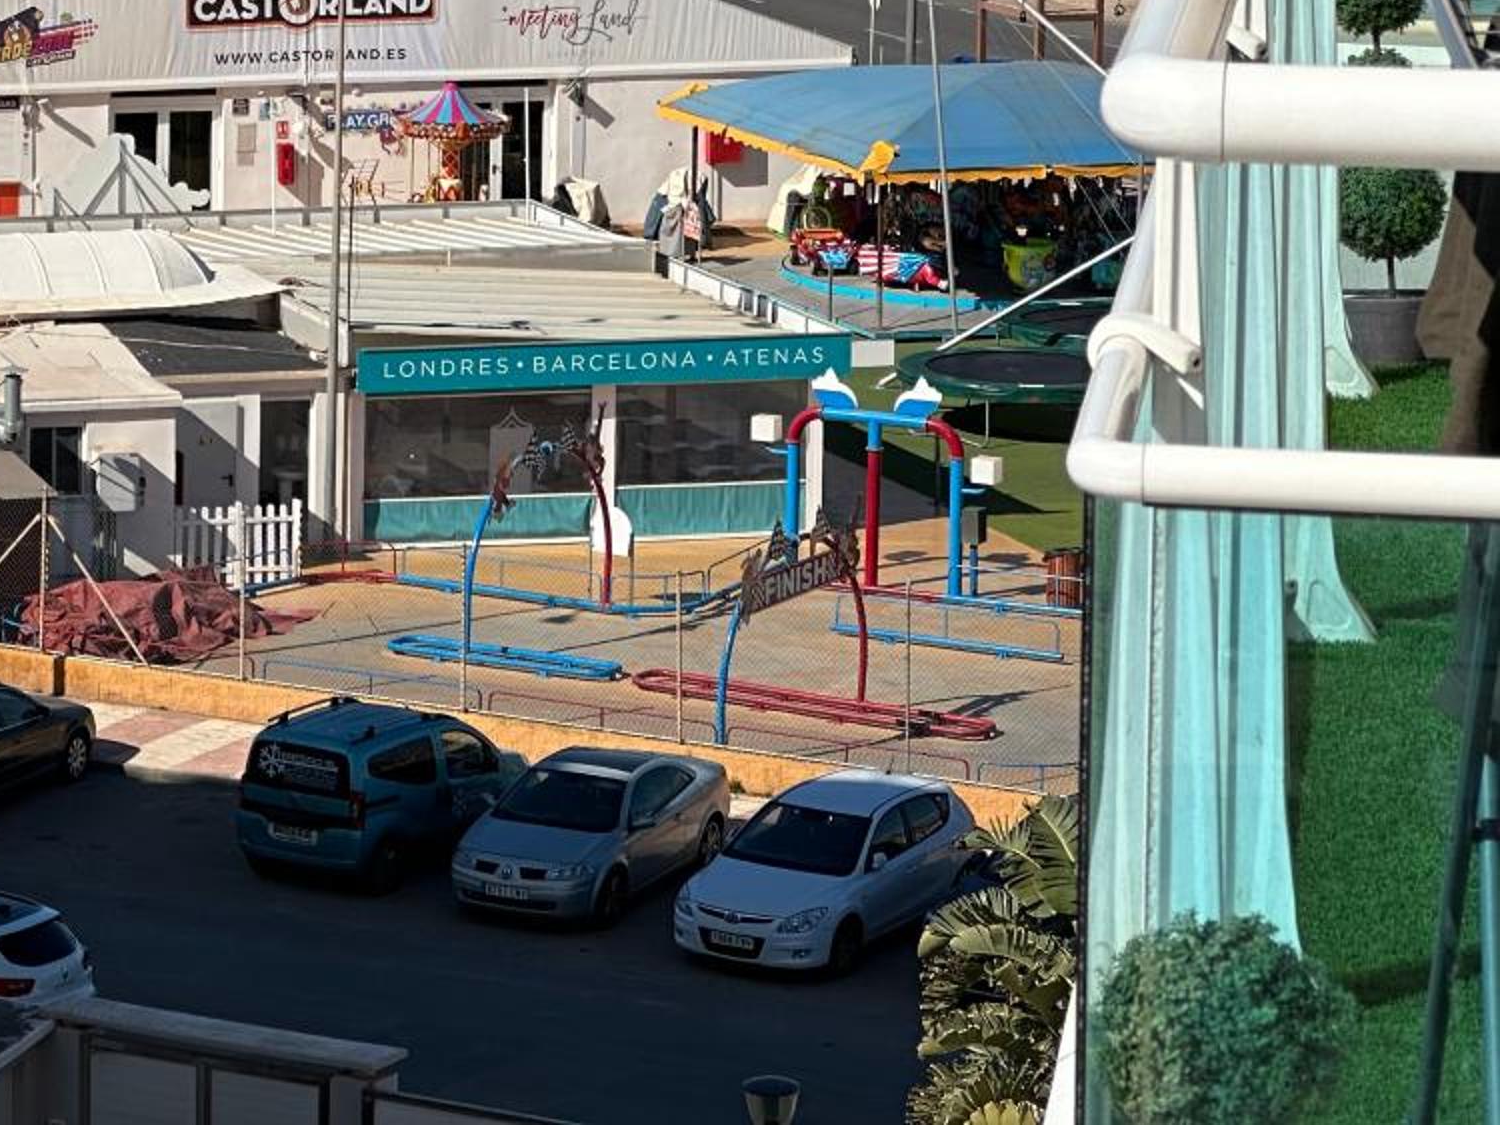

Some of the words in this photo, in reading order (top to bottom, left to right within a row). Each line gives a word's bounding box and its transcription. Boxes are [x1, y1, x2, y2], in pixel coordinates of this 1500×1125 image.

[214, 48, 406, 65] WWW.CASTORAND.ES
[383, 356, 509, 378] LONDRES
[533, 351, 696, 373] BARCELONA
[723, 346, 825, 366] ATENAS
[765, 557, 828, 605] FINISH
